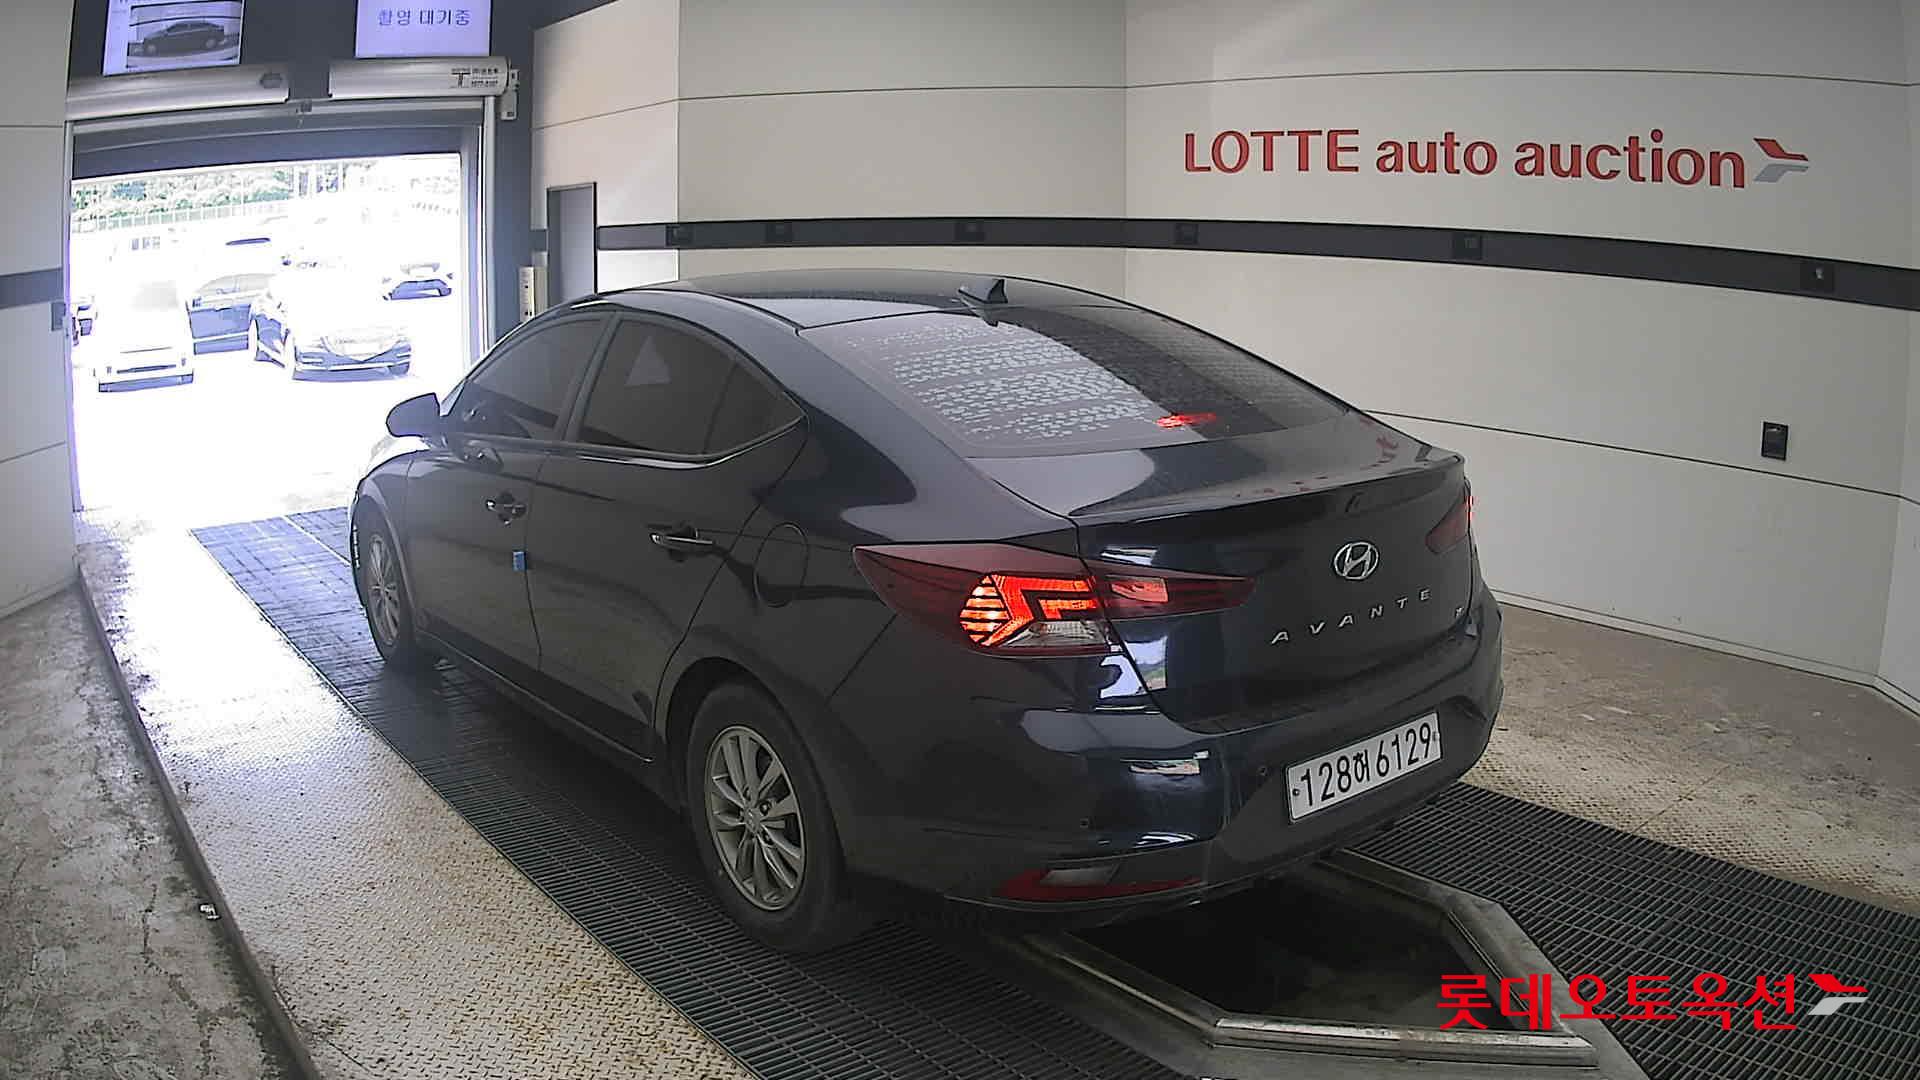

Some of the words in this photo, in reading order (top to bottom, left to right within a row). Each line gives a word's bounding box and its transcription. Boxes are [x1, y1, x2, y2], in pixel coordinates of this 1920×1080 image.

[419, 9, 471, 26] 대기중
[1185, 129, 1360, 174] LOTTE
[1375, 131, 1498, 175] auto
[1514, 128, 1745, 189] auction
[1271, 588, 1431, 645] AVANTE
[1300, 749, 1370, 807] 128허
[1376, 722, 1432, 777] 6129
